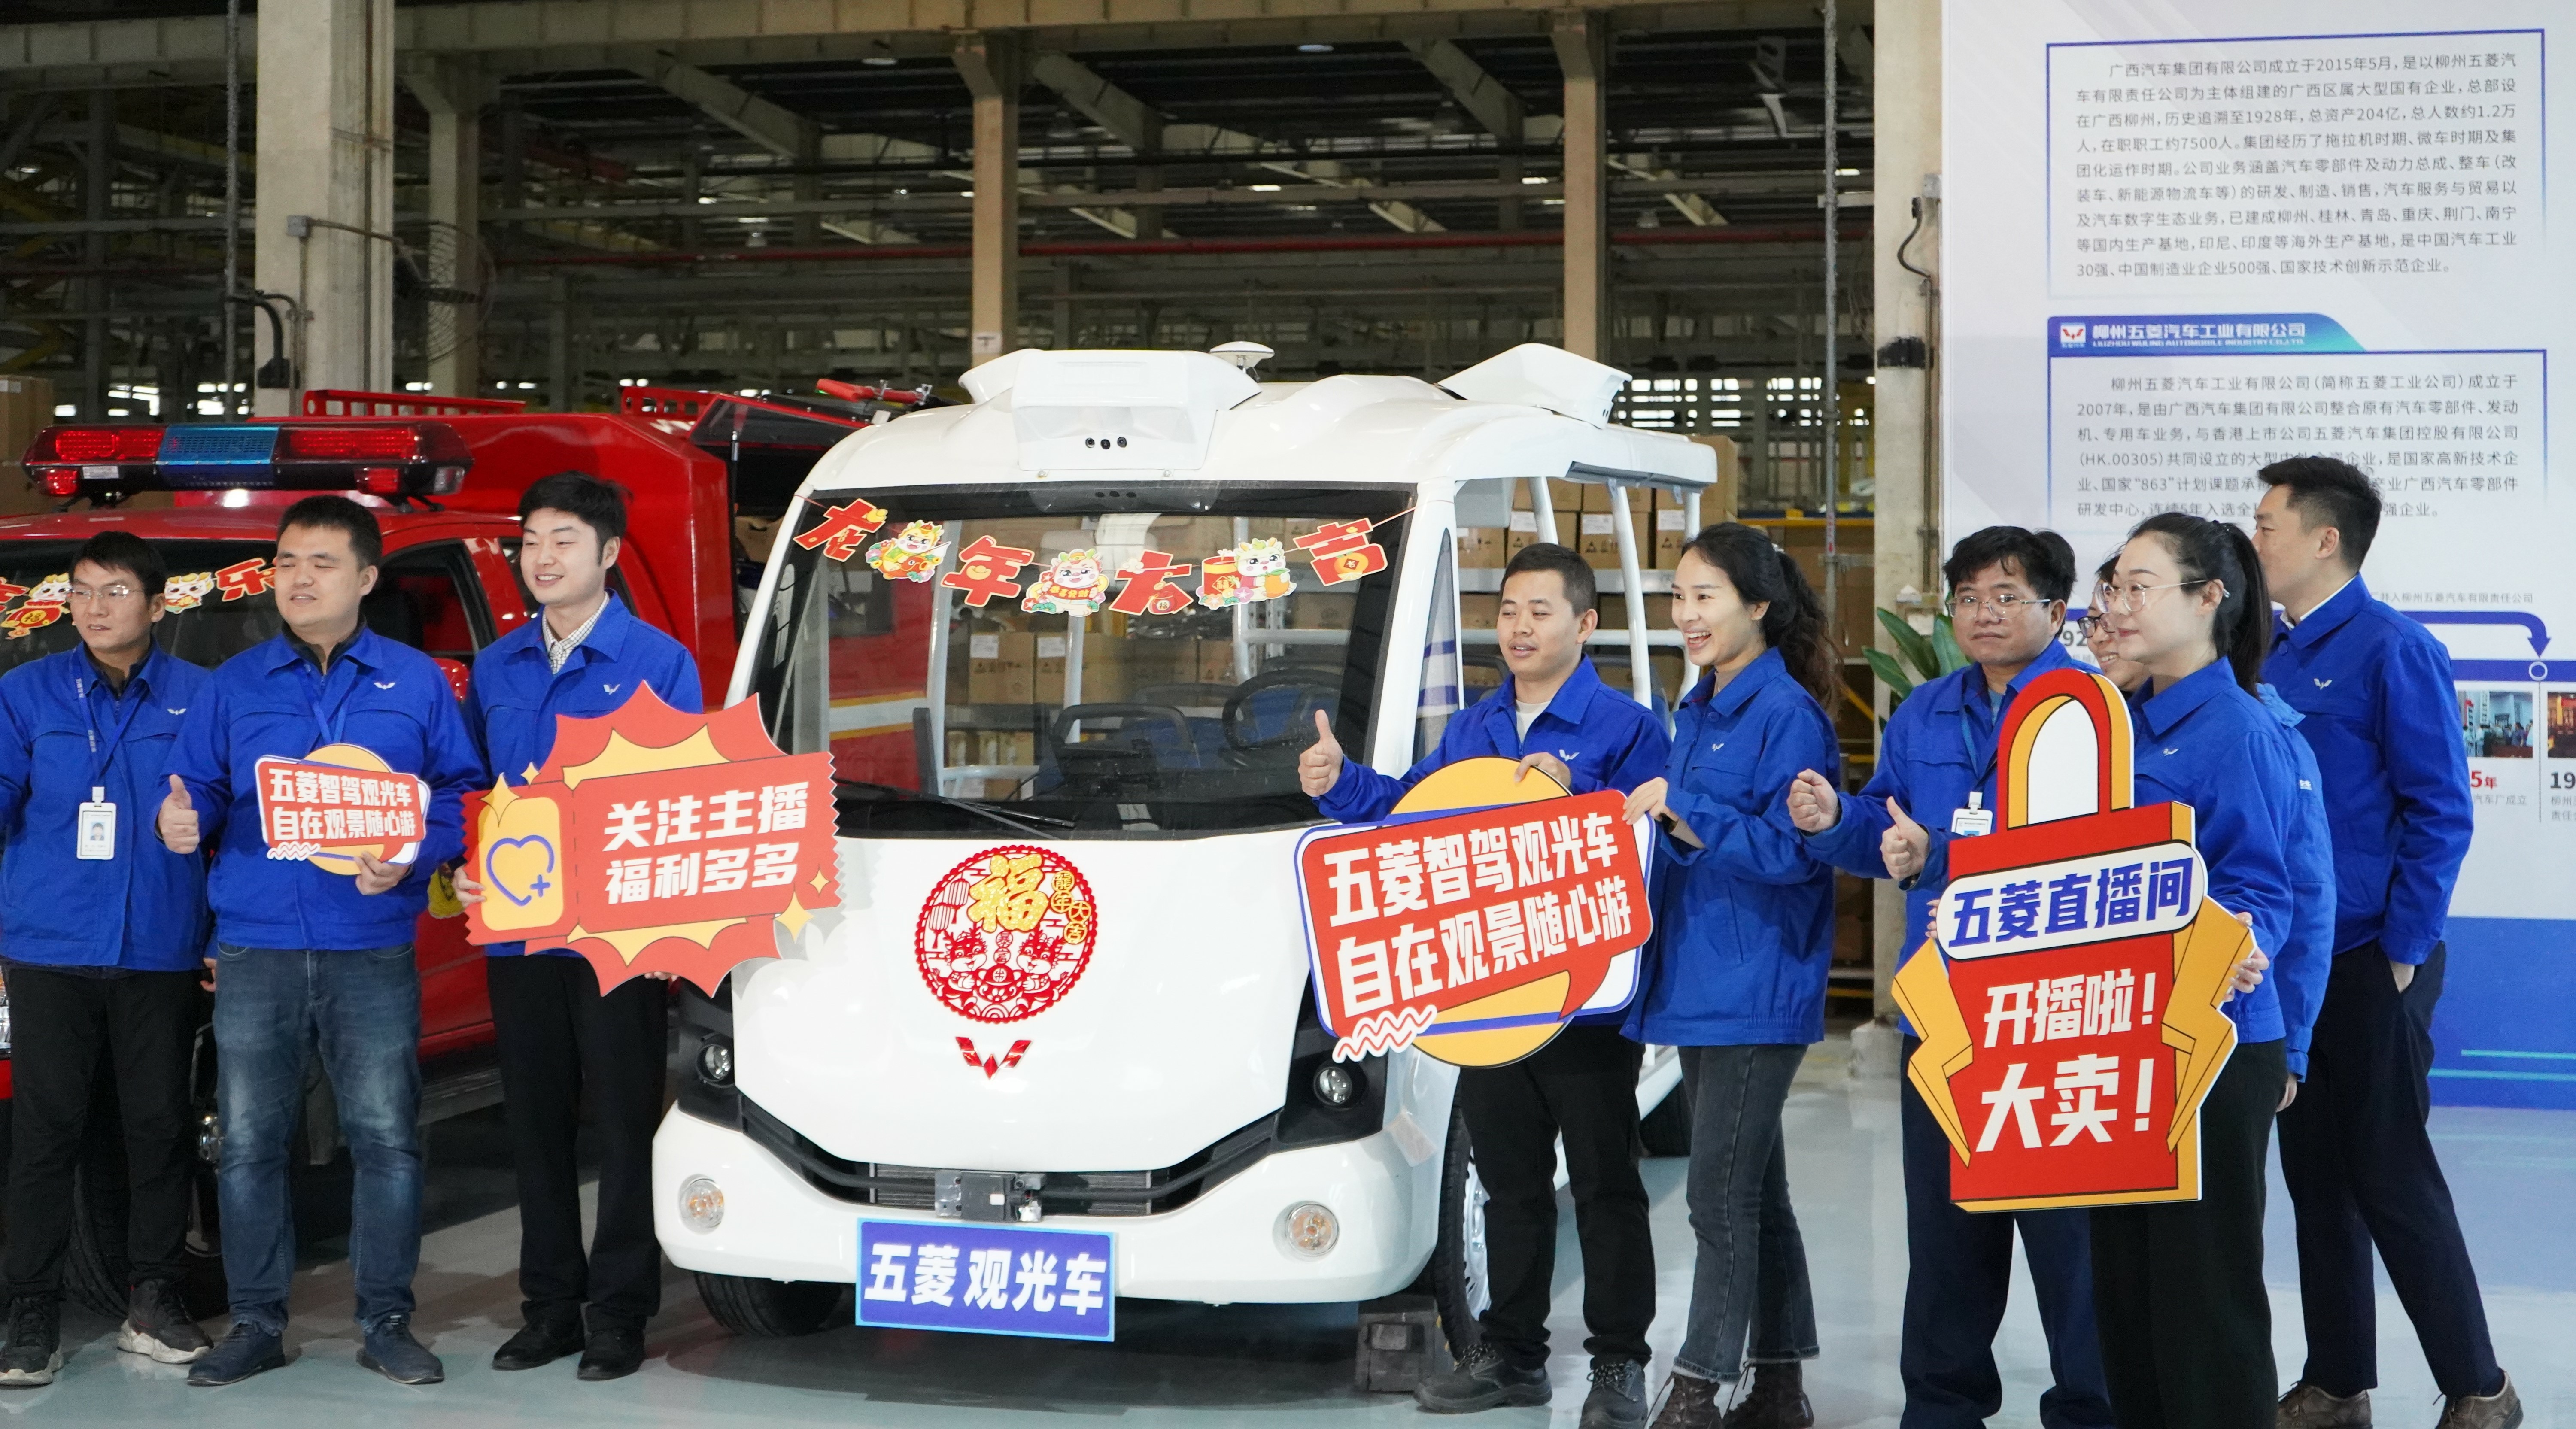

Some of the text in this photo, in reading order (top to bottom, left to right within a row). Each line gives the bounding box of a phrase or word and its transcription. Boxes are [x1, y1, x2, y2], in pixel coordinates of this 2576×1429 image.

[2109, 52, 2517, 78] 广西汽车集团有限公司成立于2015年5月，是以柳州五菱汽
[2076, 78, 2517, 104] 车有限责任公司为主体组建的广西区属大型国有企业，总部设
[2077, 231, 2517, 253] 等国内生产基地，印尼、印度等海外生产基地，是中国汽车工业
[2077, 258, 2450, 278] 30强、中国制造业企业500强、国家技术创新示范企业。
[2092, 323, 2306, 339] 柳州五菱汽车工业有限公司
[2077, 400, 2518, 417] 2007年，是由广西汽车集团有限公司整合原有汽车零部件、发动
[2077, 425, 2518, 443] 机、专用车业务，与香港上市公司五菱汽车集团控股有限公司
[269, 768, 413, 807] 五菱智驾观光车
[272, 806, 416, 842] 自在观景随心游
[602, 781, 809, 852] 关注主播
[605, 842, 799, 905] 福利多多
[969, 853, 1048, 933] 福
[1324, 812, 1619, 928] 五菱智驾观光车
[1948, 856, 2194, 949] 五菱直播间
[1336, 875, 1631, 1018] 自在观景随心游
[1983, 967, 2156, 1049] 开播啦！
[1975, 1053, 2154, 1152] 大卖！
[863, 1243, 1107, 1316] 五菱观光车
